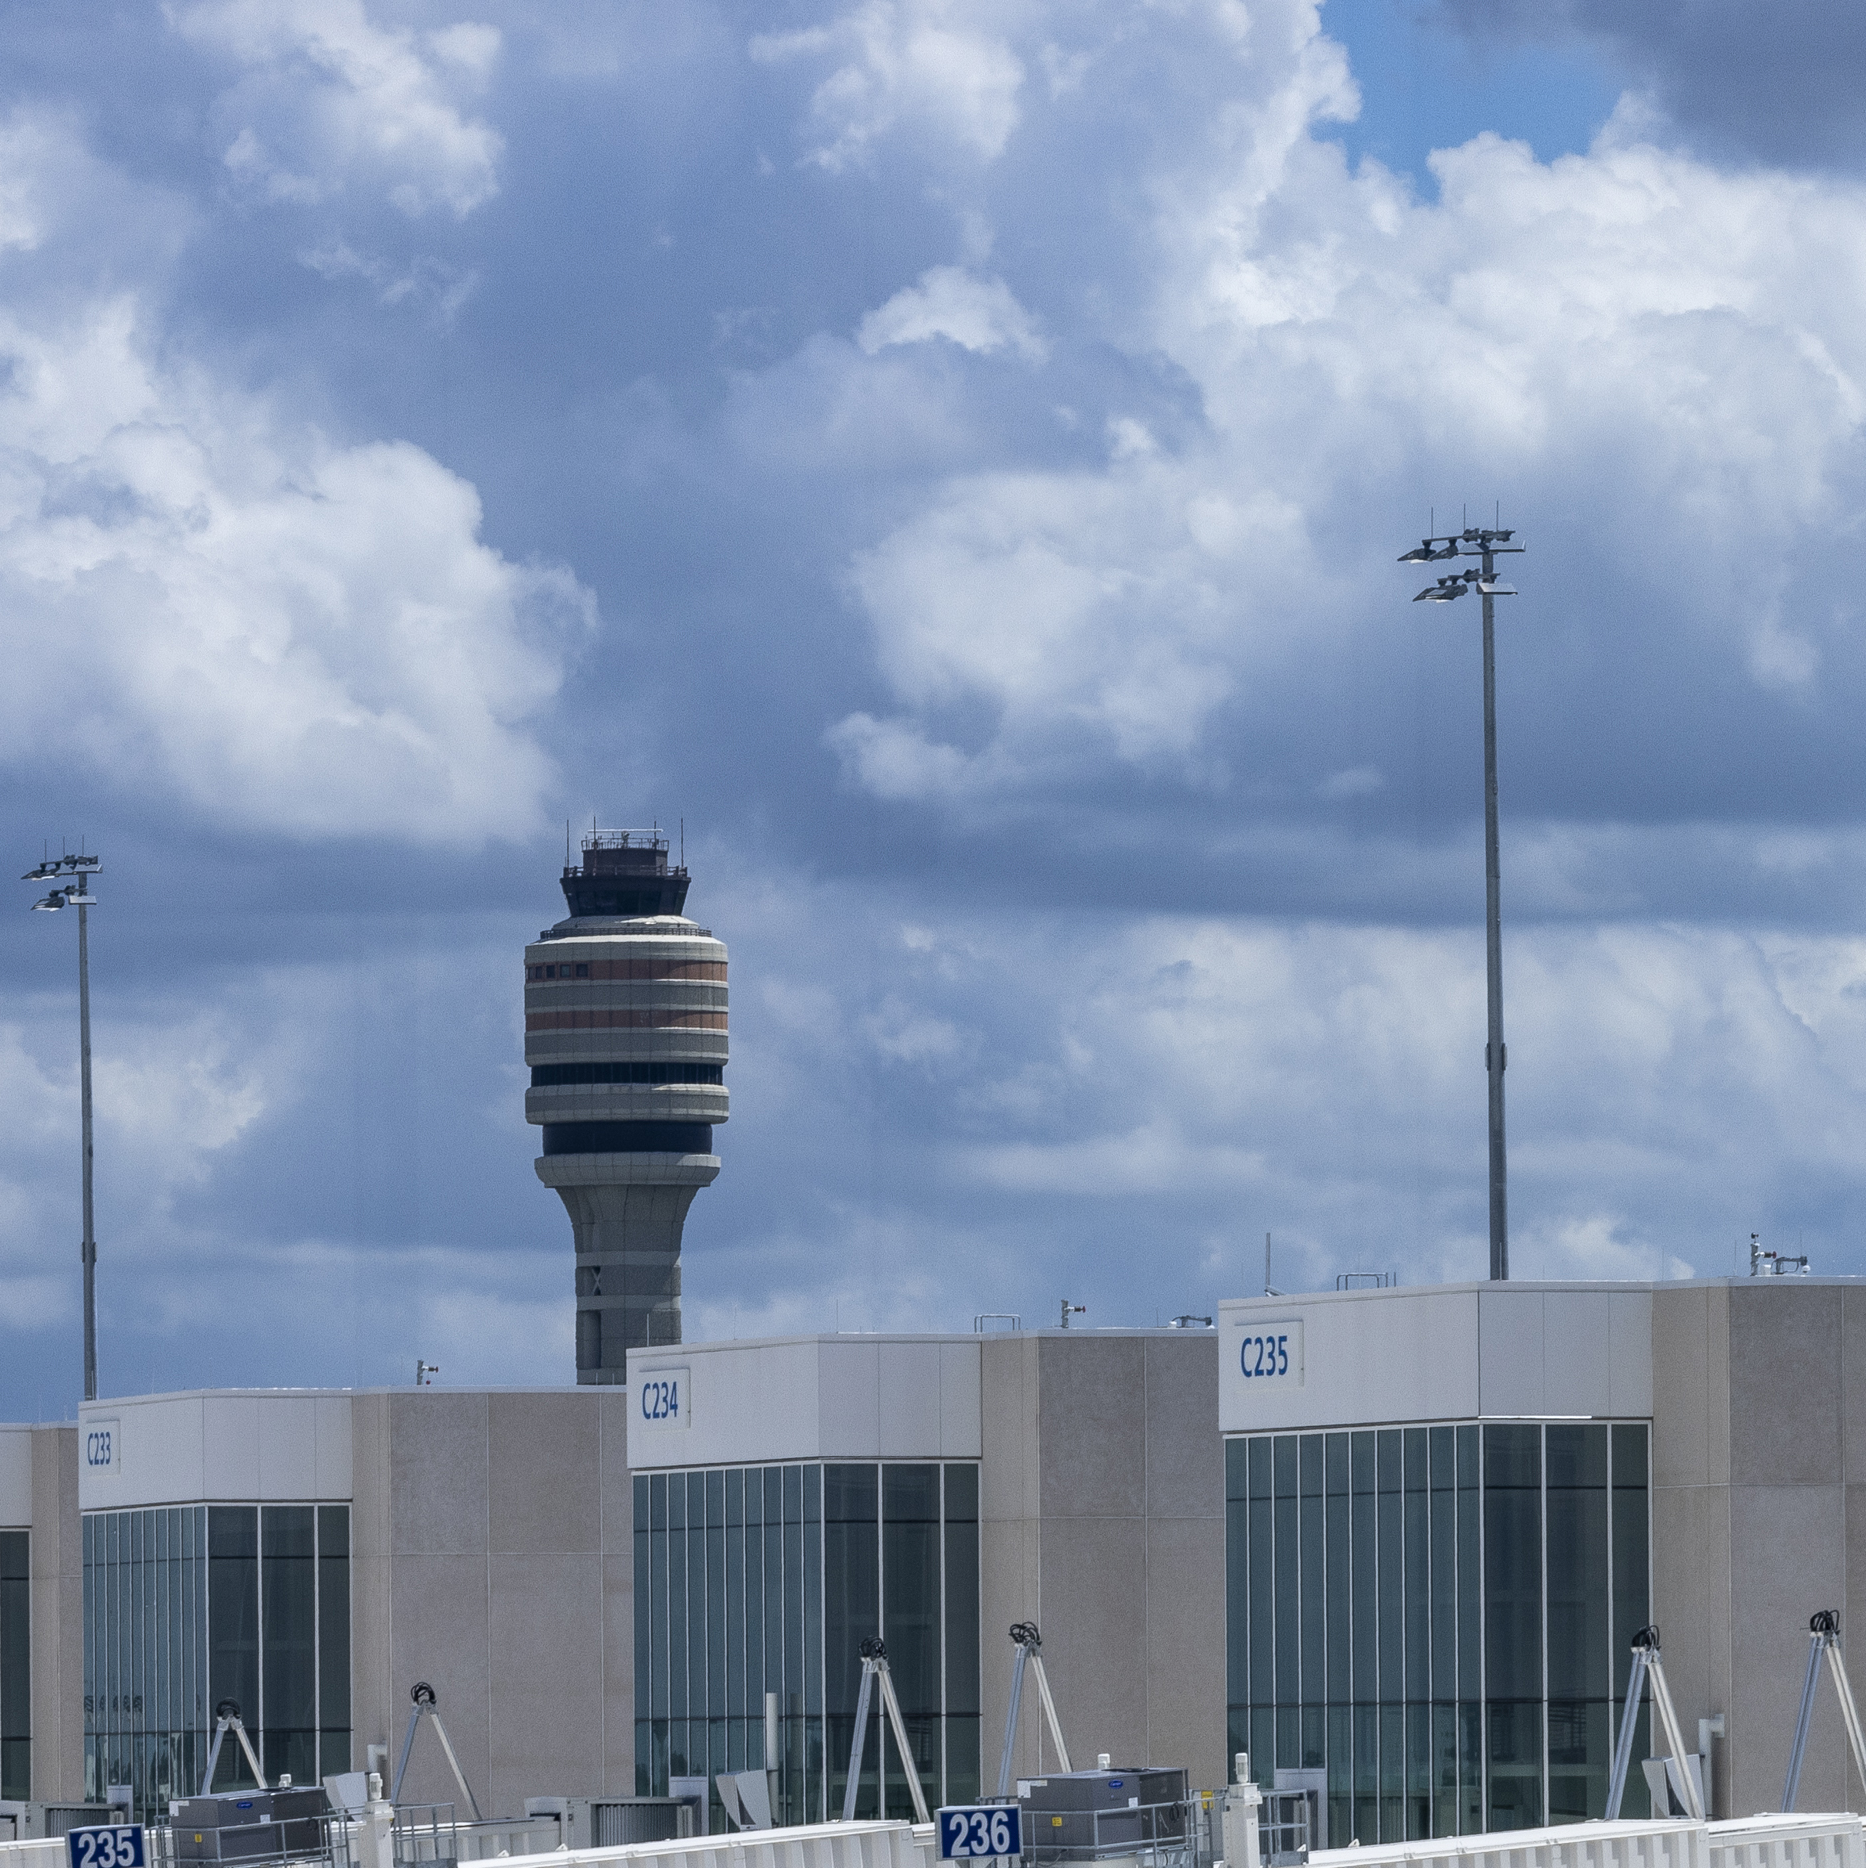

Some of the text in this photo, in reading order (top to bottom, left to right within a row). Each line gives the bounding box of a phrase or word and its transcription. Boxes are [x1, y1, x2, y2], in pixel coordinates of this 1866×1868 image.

[1240, 1335, 1288, 1378] C235
[642, 1381, 678, 1420] C234
[87, 1431, 111, 1466] C233
[949, 1811, 1010, 1857] 236
